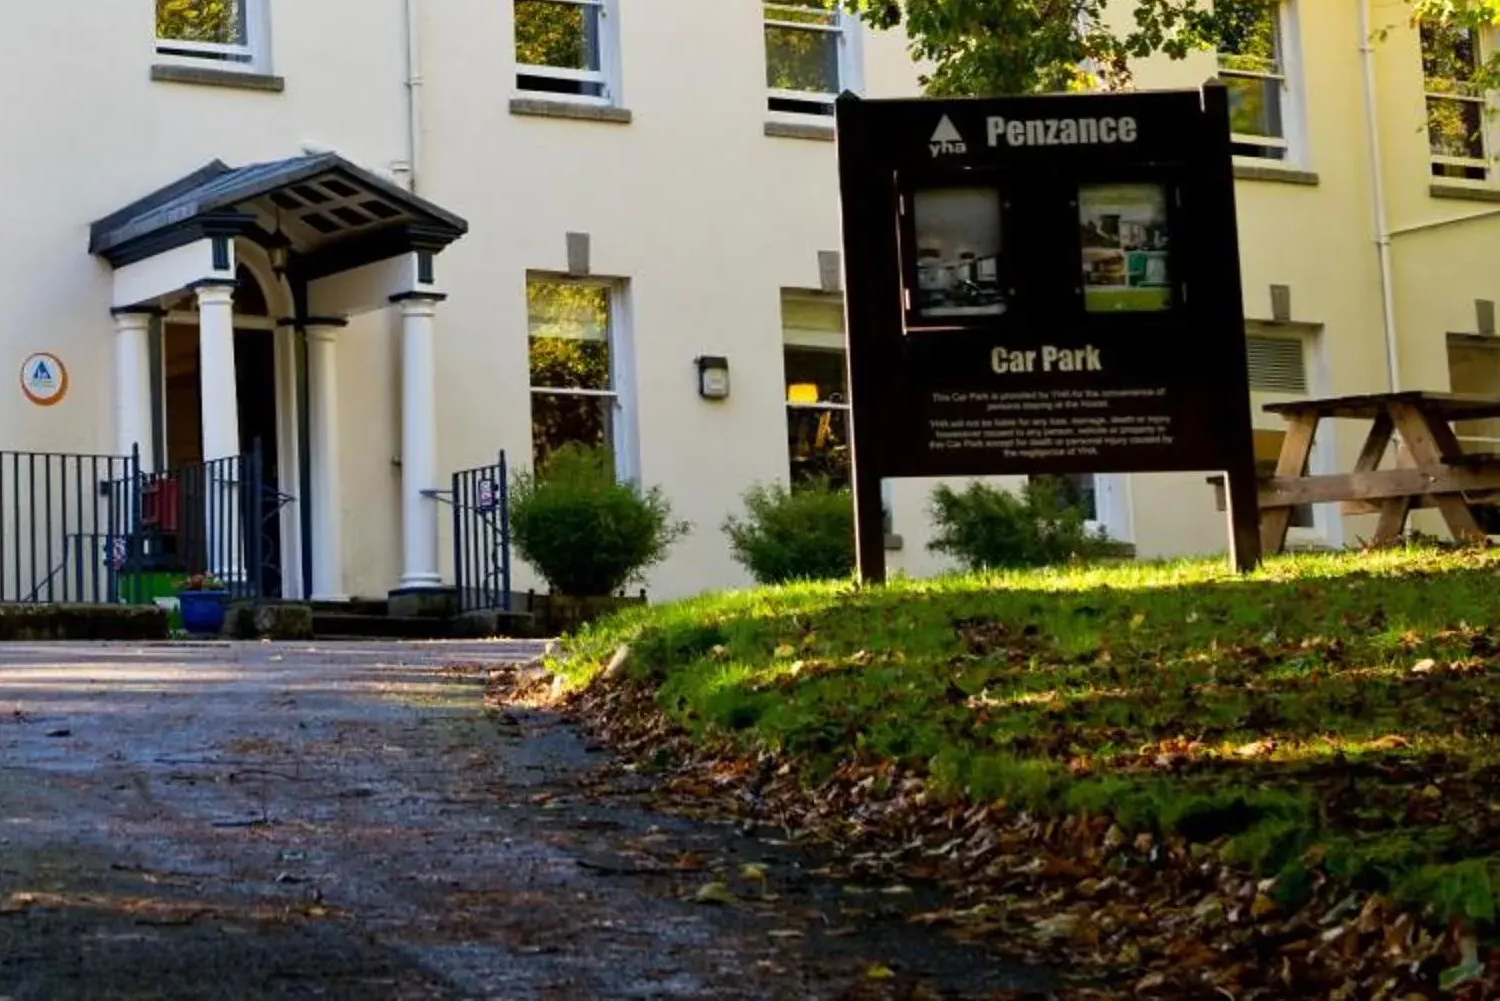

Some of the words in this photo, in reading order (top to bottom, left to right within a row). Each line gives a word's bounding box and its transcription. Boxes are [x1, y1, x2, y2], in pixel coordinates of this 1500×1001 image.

[986, 115, 1138, 147] Penzance
[929, 139, 967, 158] yha
[991, 346, 1036, 374] Car
[1041, 344, 1102, 372] Park
